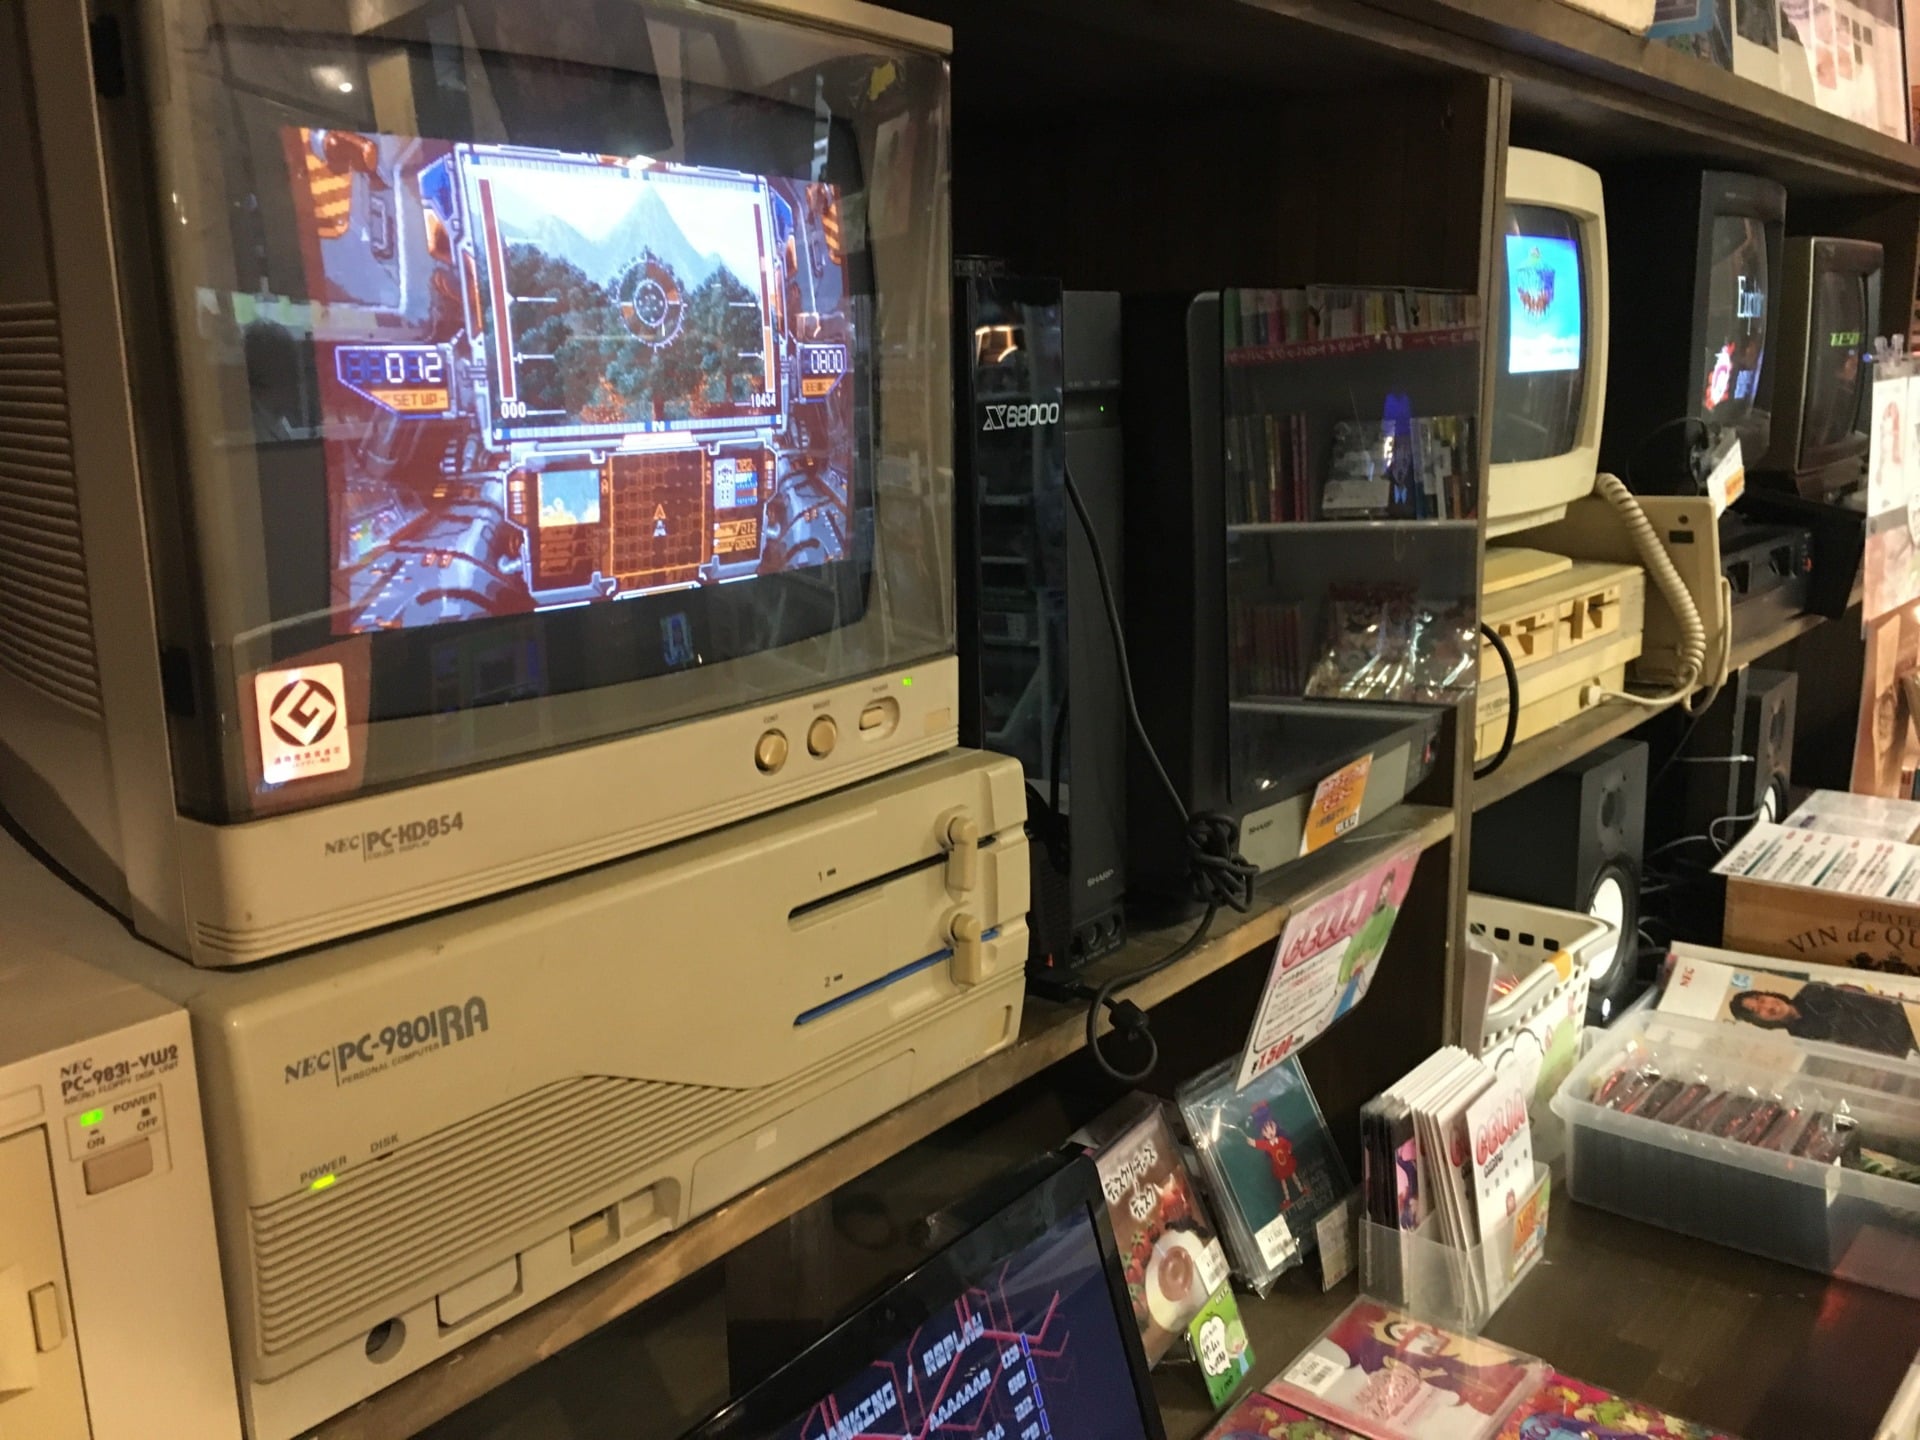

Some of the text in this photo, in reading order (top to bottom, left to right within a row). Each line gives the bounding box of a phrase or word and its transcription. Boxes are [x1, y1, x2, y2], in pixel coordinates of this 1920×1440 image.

[811, 349, 844, 374] 0800
[501, 401, 527, 419] 000
[751, 392, 776, 408] 10434
[982, 402, 1060, 431] X68000
[325, 834, 361, 857] NEC
[1787, 926, 1839, 954] VIN
[1848, 921, 1877, 944] de
[284, 995, 489, 1085] NEC PC-9801RA
[60, 1057, 93, 1078] NEC
[113, 1091, 157, 1114] POWER
[137, 1116, 158, 1132] OFF
[87, 1136, 106, 1150] ON
[370, 1133, 400, 1153] DISK
[300, 1154, 347, 1183] POWER
